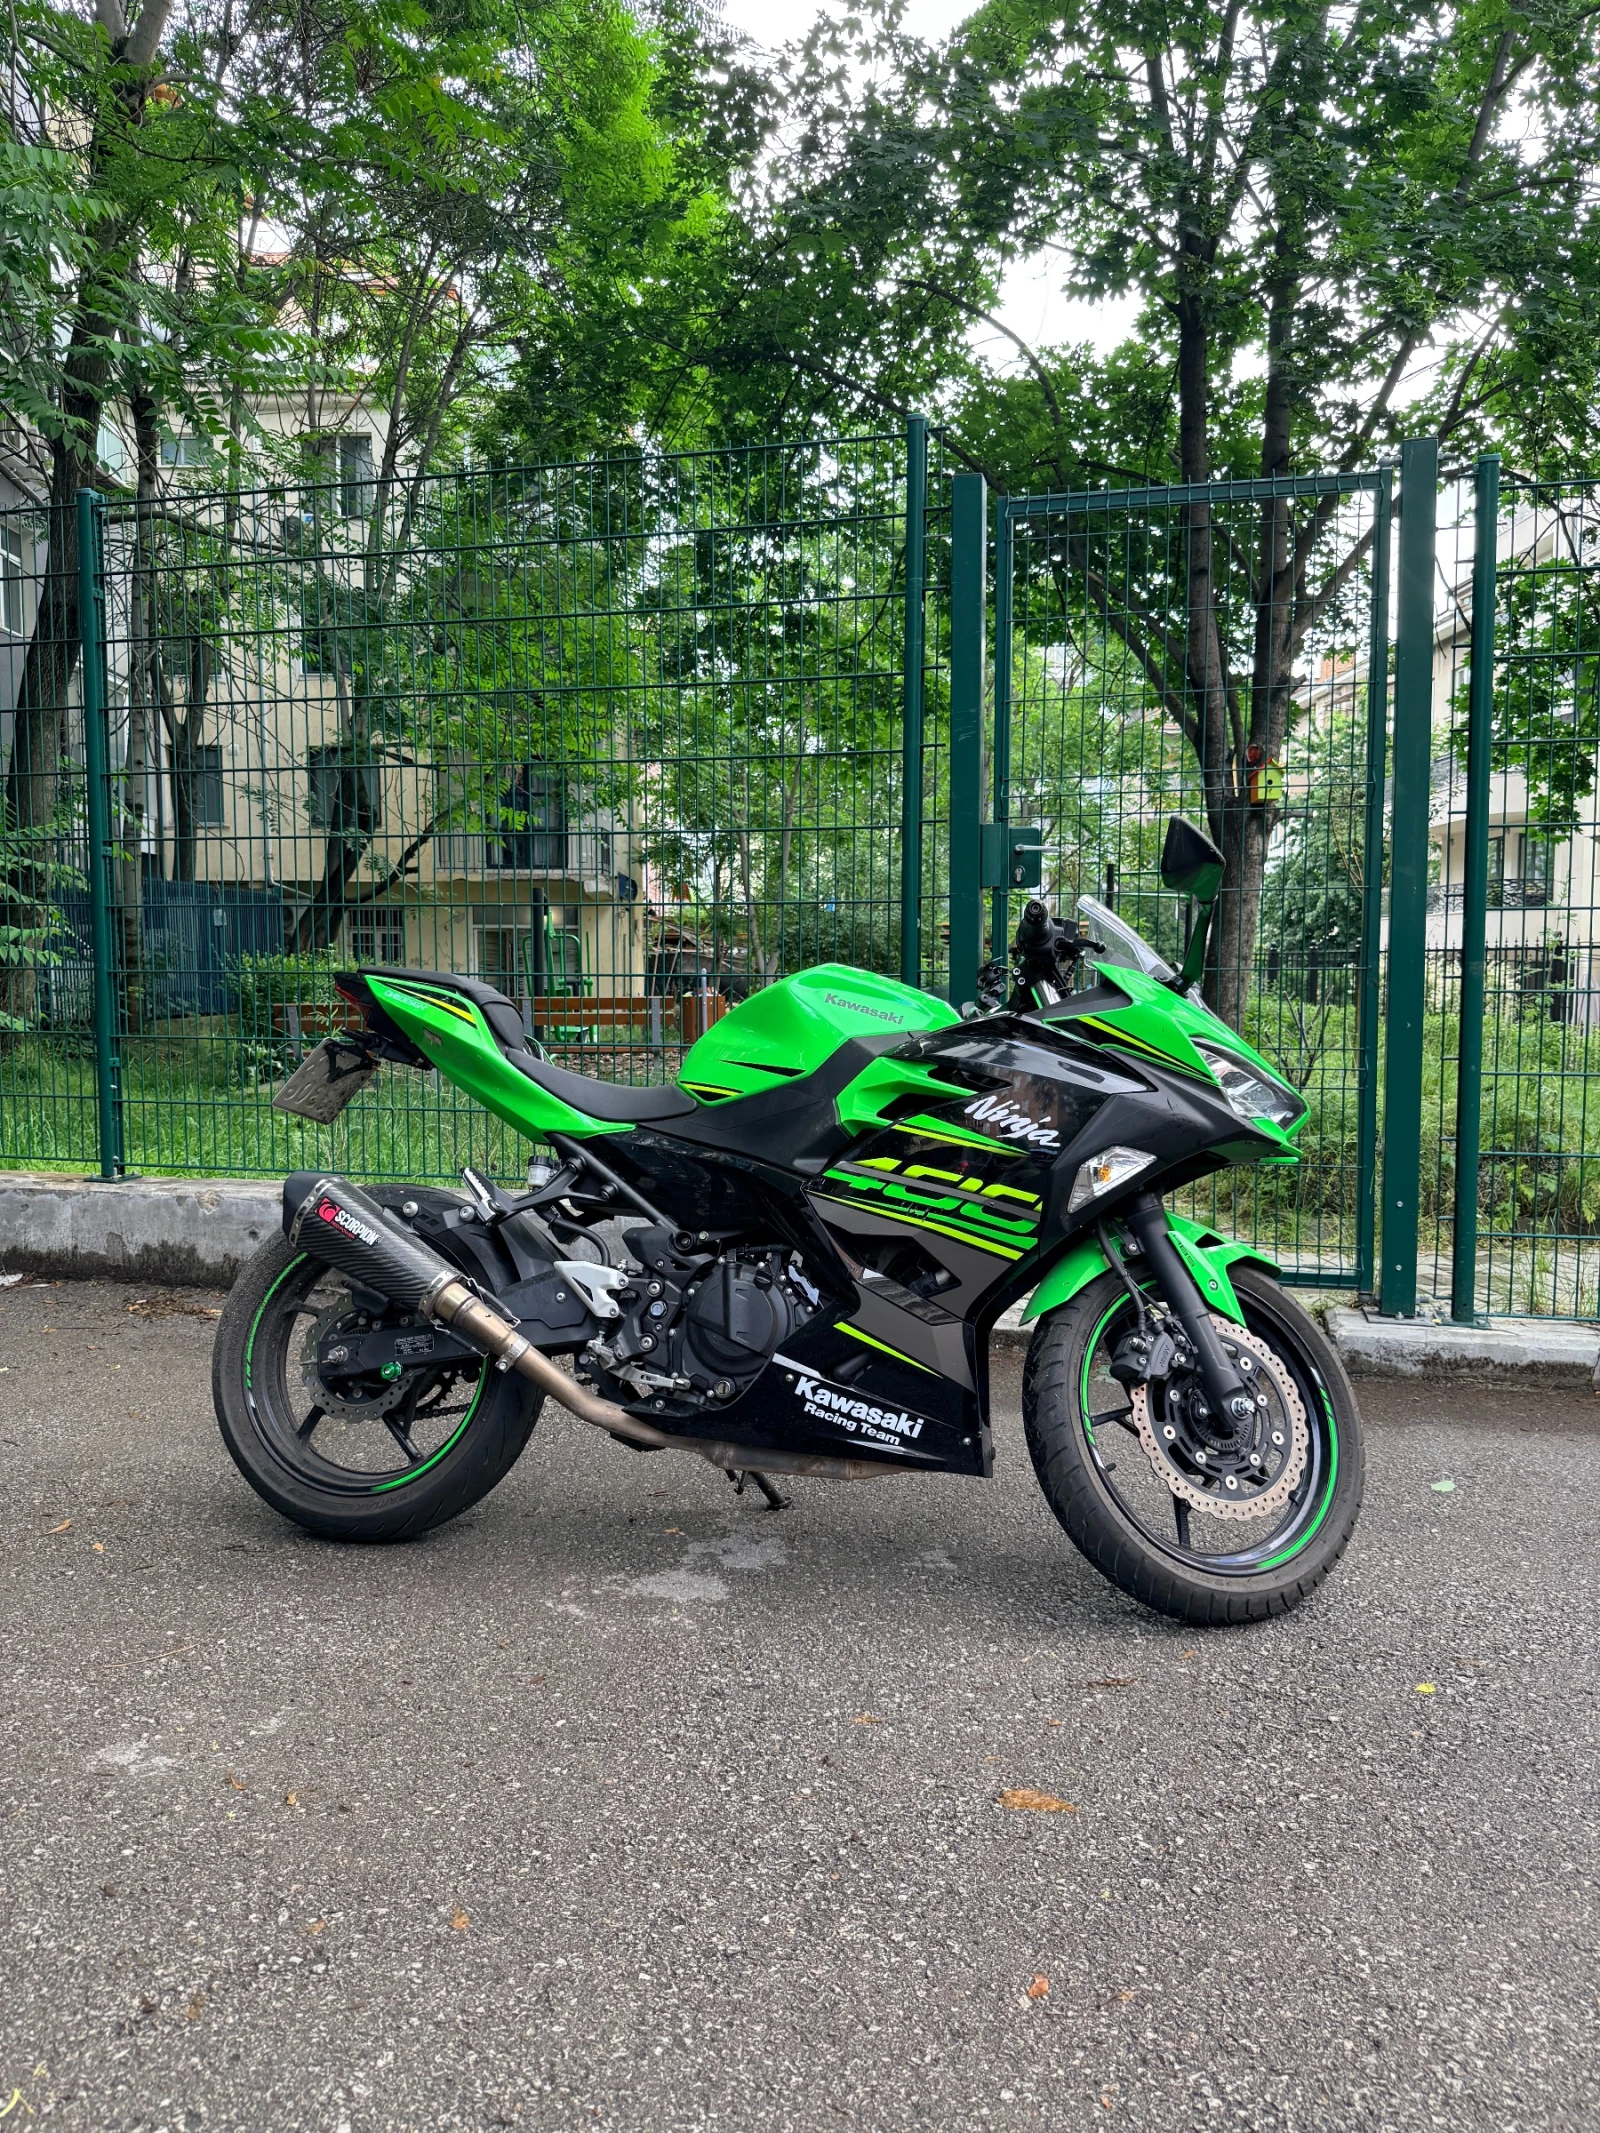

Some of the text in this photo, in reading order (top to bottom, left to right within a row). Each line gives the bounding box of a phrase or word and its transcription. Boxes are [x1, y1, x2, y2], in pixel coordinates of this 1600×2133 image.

[825, 993, 904, 1025] Kawasaki
[964, 1095, 1061, 1147] Ninja
[822, 1157, 1043, 1234] 400
[334, 1209, 380, 1246] SCORPION
[794, 1375, 924, 1439] Kawasaki
[803, 1401, 900, 1446] Racing Team
